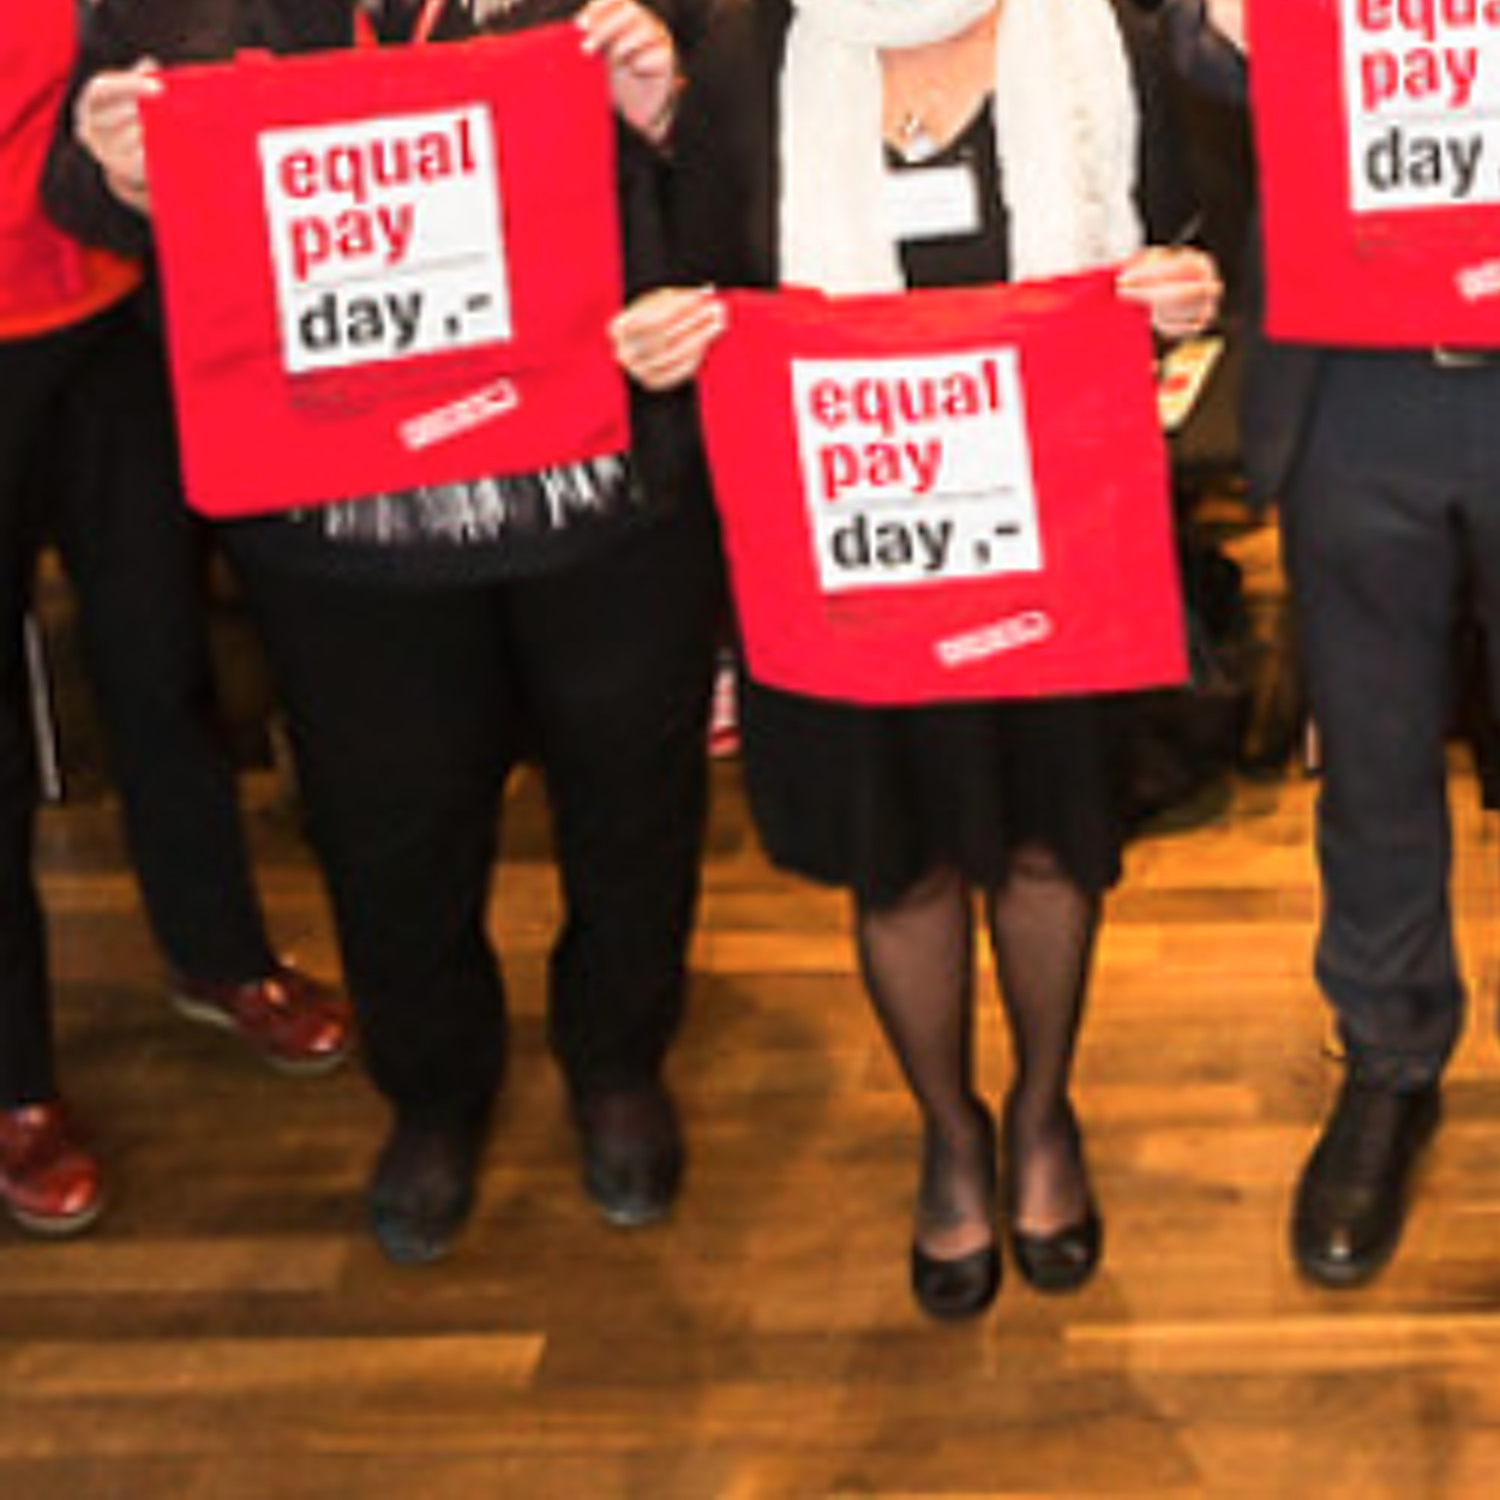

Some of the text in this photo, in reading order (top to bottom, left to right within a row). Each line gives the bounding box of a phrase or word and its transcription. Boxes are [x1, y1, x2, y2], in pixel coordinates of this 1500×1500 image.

[1361, 47, 1480, 113] pay
[276, 117, 476, 204] equal
[289, 203, 414, 283] pay
[809, 358, 1002, 437] equal
[819, 437, 943, 501] pay
